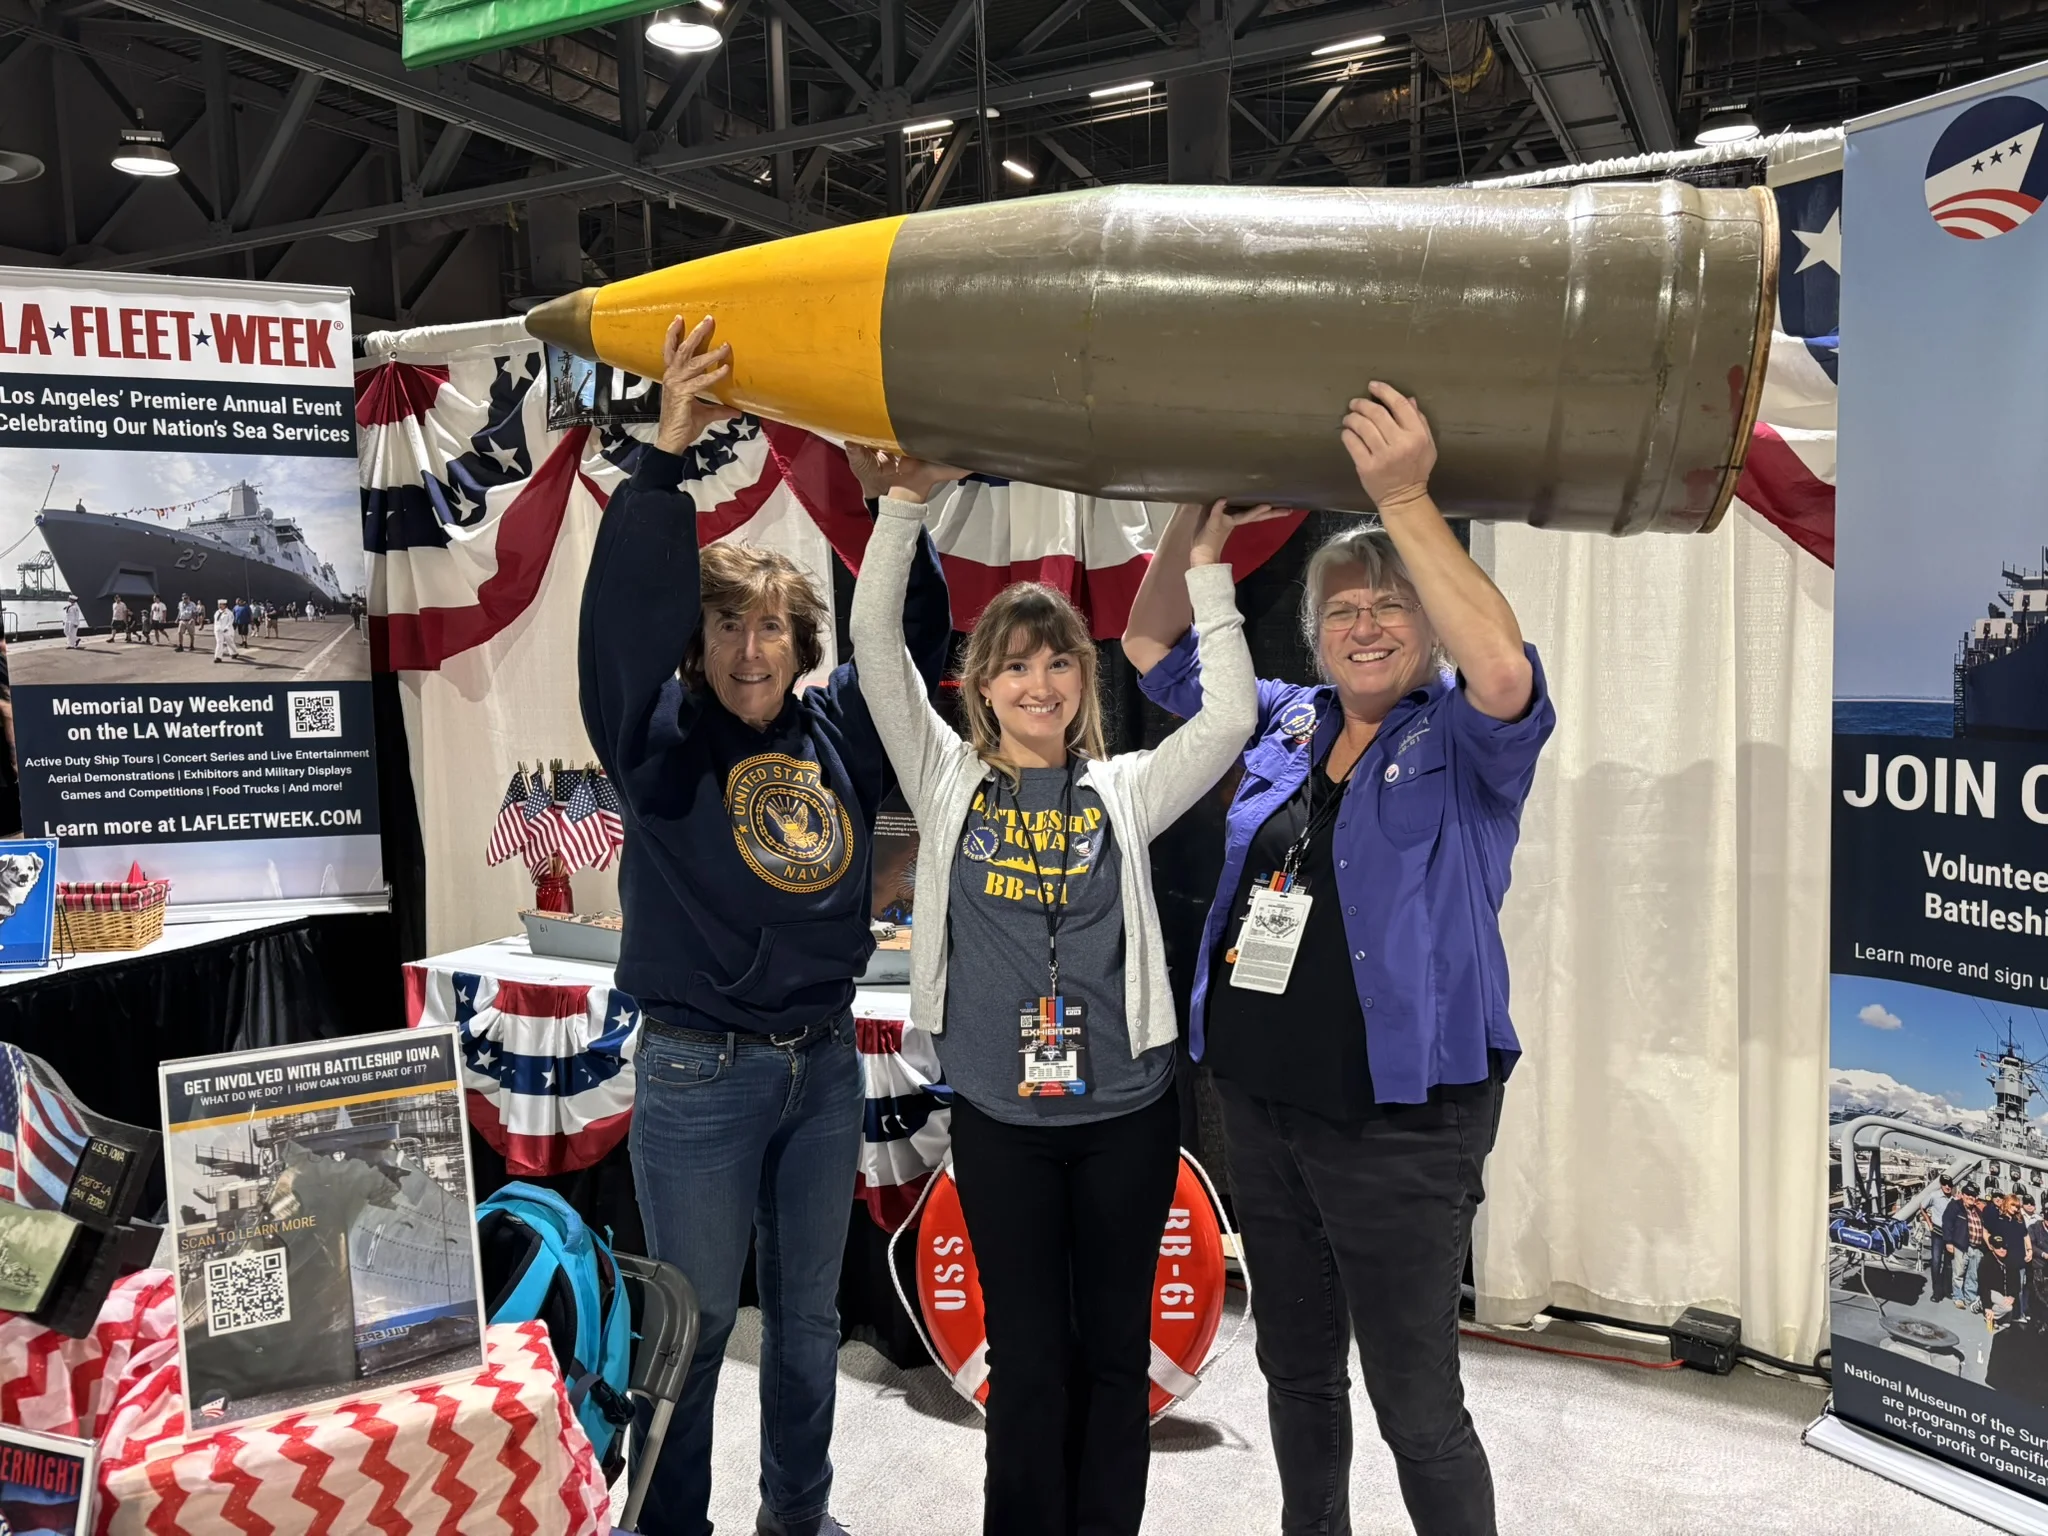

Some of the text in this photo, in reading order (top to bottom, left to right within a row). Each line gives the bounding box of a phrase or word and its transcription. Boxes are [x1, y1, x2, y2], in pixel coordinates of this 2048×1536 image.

[0, 302, 52, 355] LA
[70, 306, 195, 361] FLEET
[0, 386, 35, 405] Los
[130, 391, 217, 411] Premiere
[223, 394, 287, 414] Annual
[292, 398, 342, 416] Event
[0, 413, 107, 438] Celebrating
[113, 416, 147, 434] Our
[232, 421, 267, 439] Sea
[272, 423, 350, 443] Services
[174, 548, 208, 572] 23
[52, 694, 274, 718] Memorial Day Weekend
[67, 719, 264, 741] on the LA Waterfront
[25, 756, 62, 767] Active
[64, 755, 91, 769] Duty
[94, 754, 120, 766] Ship
[121, 754, 154, 764] Tours
[162, 752, 207, 763] Concert
[210, 751, 245, 762] Series
[247, 751, 268, 761] and
[270, 750, 293, 761] Live
[295, 749, 370, 760] Entertainment
[48, 772, 81, 783] Aerial
[84, 770, 175, 782] Demonstrations
[184, 769, 239, 780] Exhibitors
[242, 767, 263, 778] and
[264, 766, 305, 779] Military
[307, 765, 352, 778] Displays
[61, 790, 101, 800] Games
[104, 787, 126, 799] and
[128, 785, 204, 799] Competitions
[212, 784, 241, 795] Food
[242, 783, 280, 794] Trucks
[288, 782, 310, 793] And
[312, 781, 343, 792] more!
[734, 768, 767, 816] UNITED
[1842, 754, 1996, 819] JOIN
[44, 808, 362, 837] Learn more at LAFLEETWEEK.COM
[1004, 827, 1067, 852] IOWA
[783, 859, 832, 881] NAVY
[984, 870, 1069, 905] BB-61
[540, 924, 549, 933] 61
[1855, 942, 1904, 964] Learn
[1910, 951, 1953, 973] more
[1957, 961, 1989, 980] and
[1994, 967, 2033, 990] sign
[1021, 1027, 1082, 1037] EXHIBITOR
[184, 1045, 440, 1095] GET INVOLVED WITH BATTLESHIP IOWA
[200, 1093, 230, 1106] WHAT
[231, 1091, 246, 1102] DO
[247, 1088, 263, 1099] WE
[264, 1085, 283, 1097] DO?
[295, 1080, 318, 1092] HOW
[319, 1077, 339, 1088] CAN
[341, 1074, 360, 1085] YOU
[361, 1071, 374, 1082] BE
[375, 1067, 399, 1079] PART
[400, 1065, 413, 1076] OF
[414, 1063, 427, 1075] IT?
[180, 1215, 317, 1250] SCAN TO LEARN MORE
[933, 1236, 966, 1311] USS
[1843, 1362, 1902, 1393] National
[1905, 1384, 1967, 1418] Museum
[1971, 1409, 1987, 1426] of
[1990, 1417, 2015, 1437] the
[1881, 1395, 1904, 1411] are
[1907, 1404, 1976, 1440] programs
[1980, 1429, 1996, 1447] of
[1884, 1412, 1976, 1458] not-for-profit
